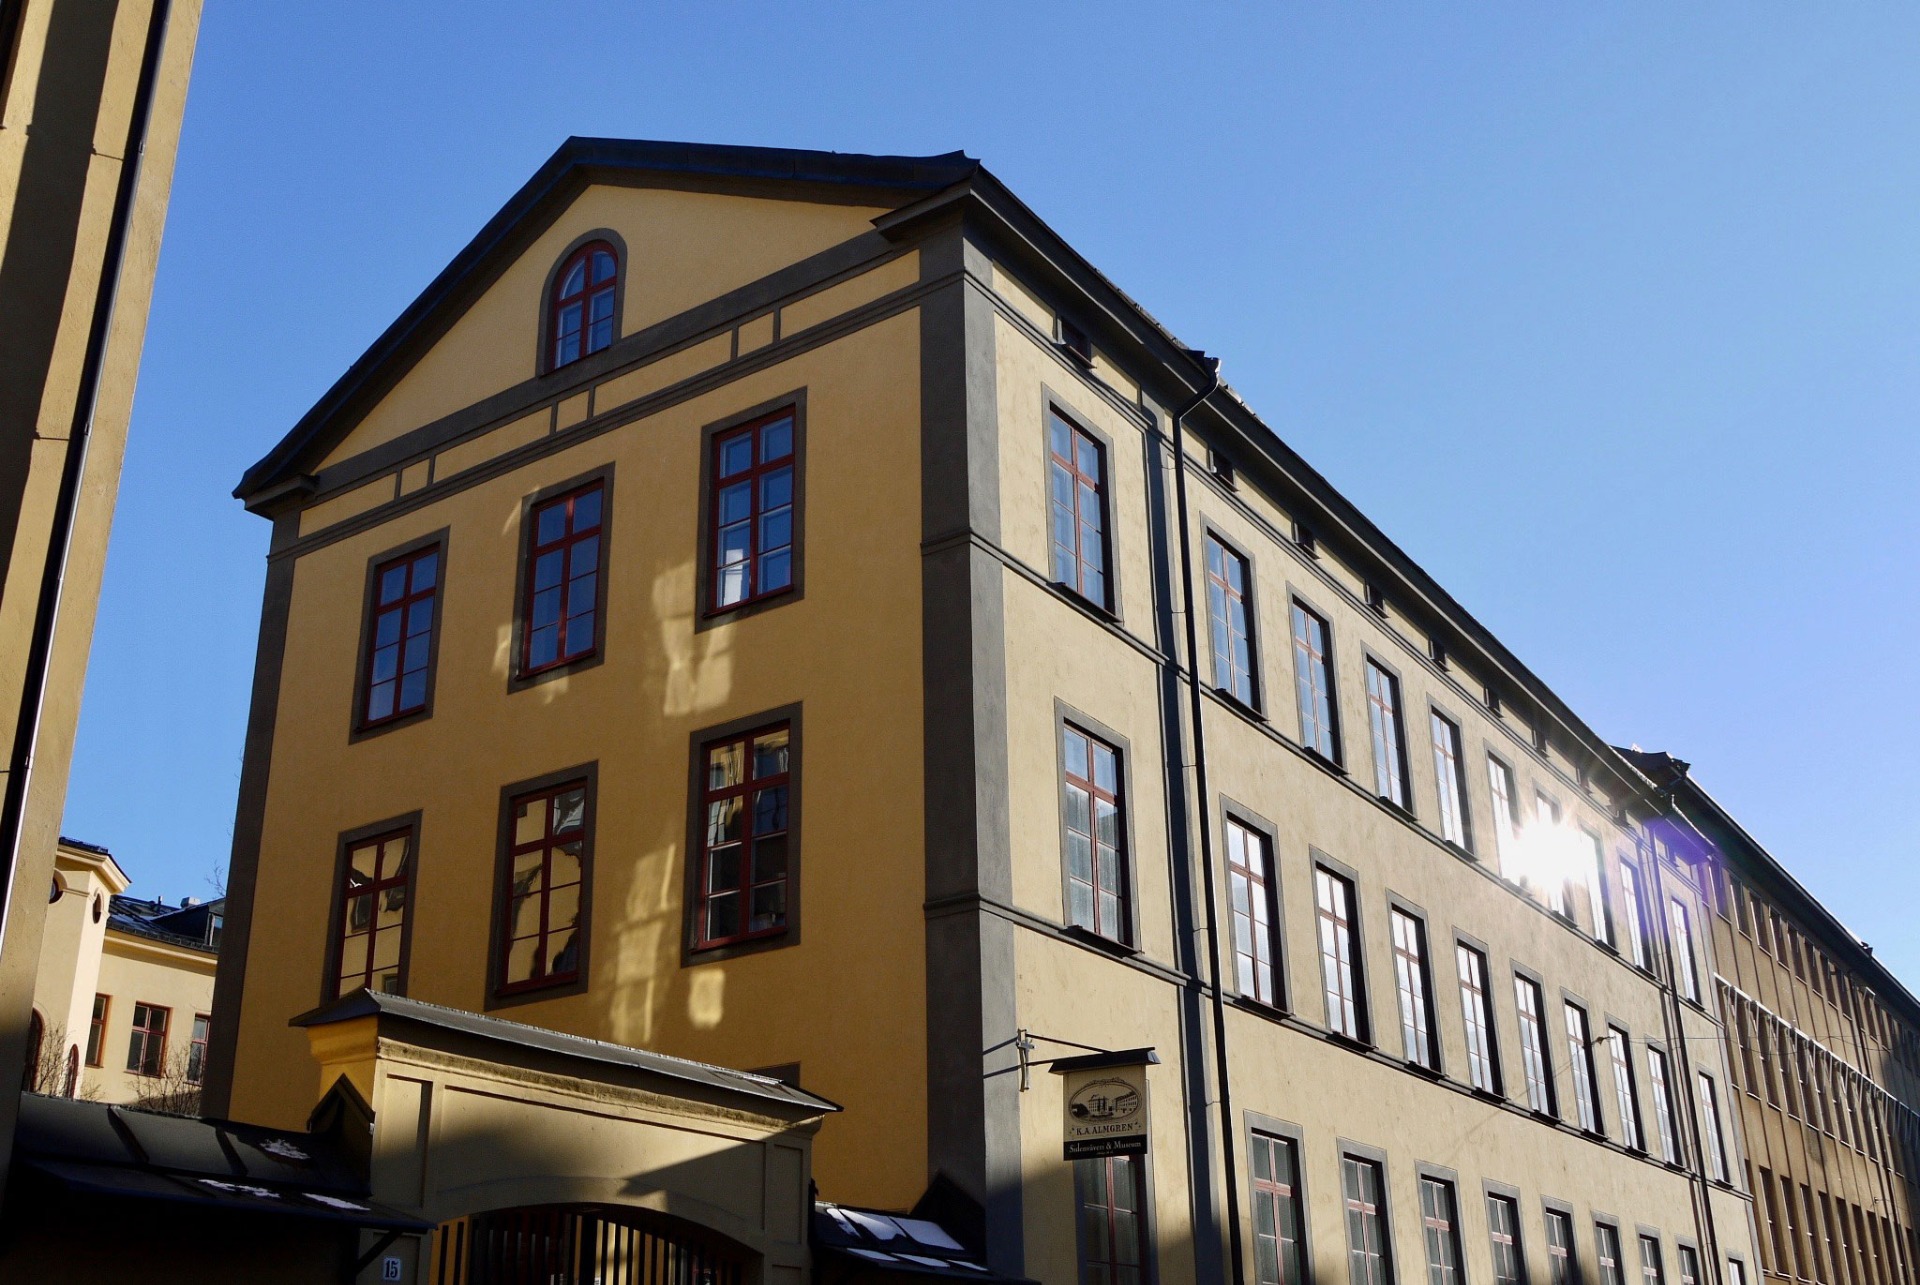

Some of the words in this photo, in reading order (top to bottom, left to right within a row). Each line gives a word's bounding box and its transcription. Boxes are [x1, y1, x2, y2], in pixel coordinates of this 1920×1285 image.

[1092, 1122, 1133, 1135] ALMGREN
[1106, 1142, 1113, 1150] &
[1114, 1140, 1142, 1150] Museum
[385, 1260, 398, 1278] 15
